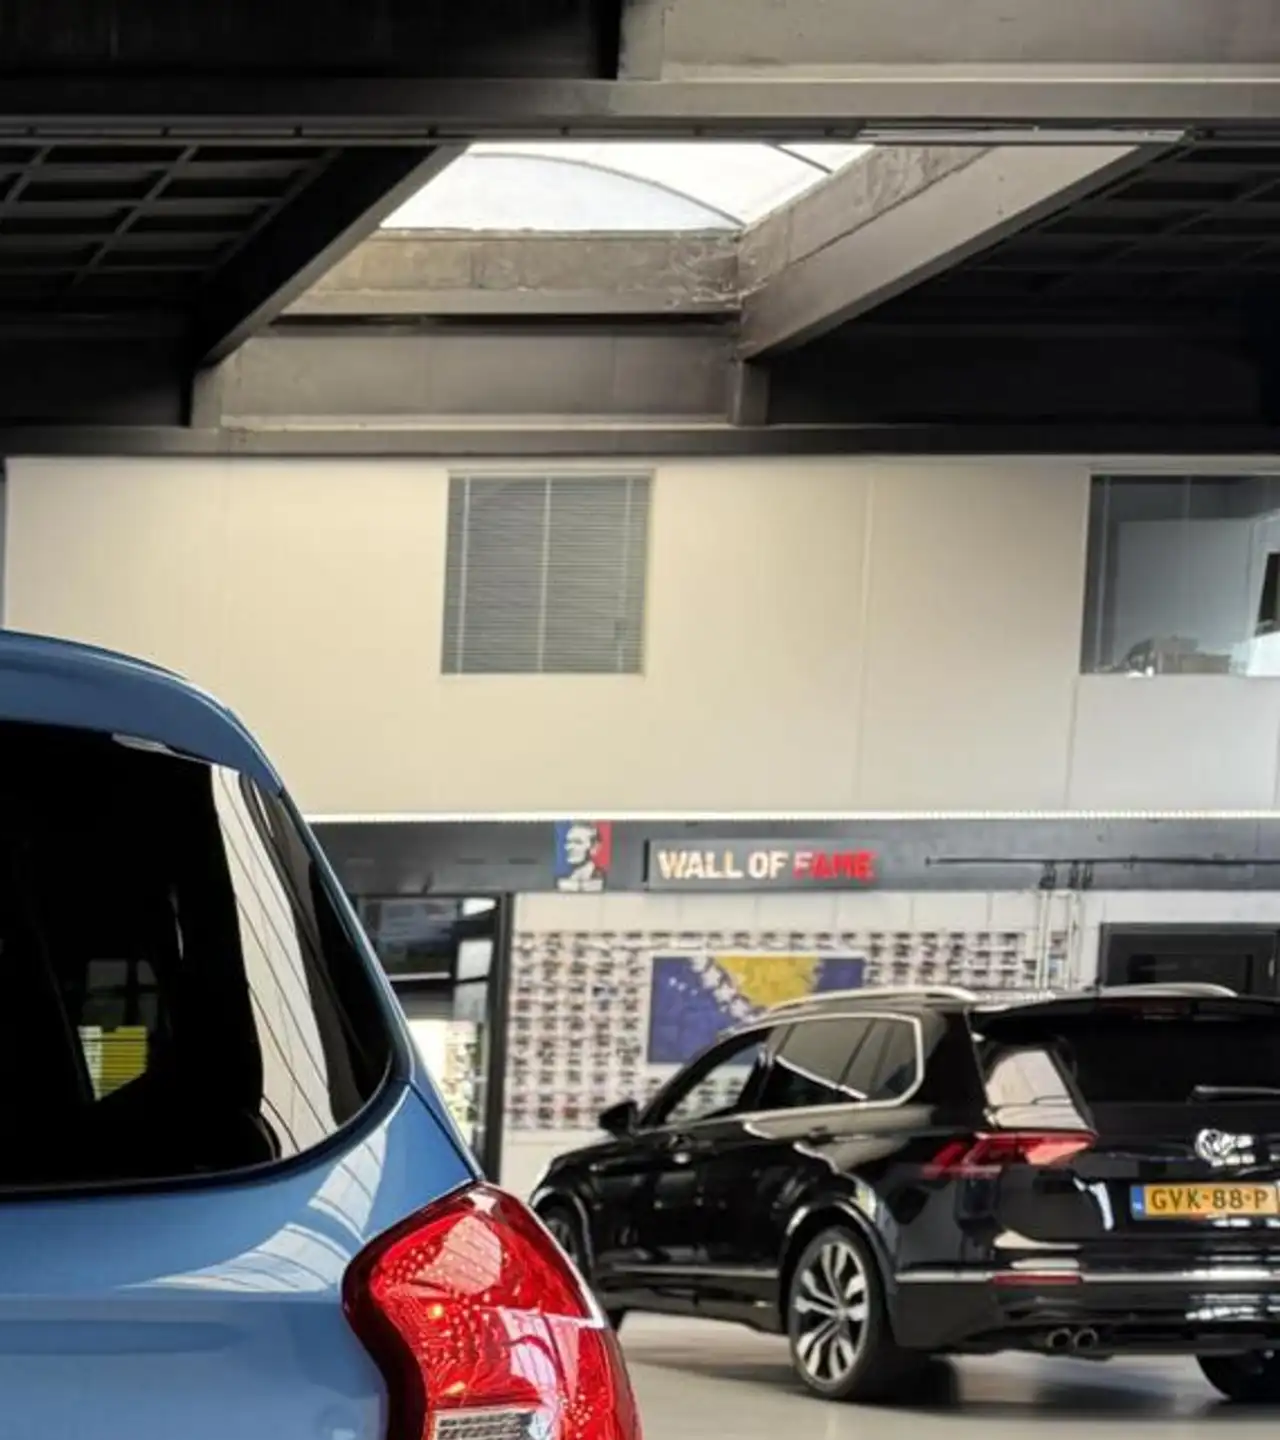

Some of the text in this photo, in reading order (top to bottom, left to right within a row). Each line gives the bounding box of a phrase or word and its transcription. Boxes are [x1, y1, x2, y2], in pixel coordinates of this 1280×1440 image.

[657, 849, 877, 881] WALL OF FAME
[1150, 1187, 1269, 1210] GVK-88-P
